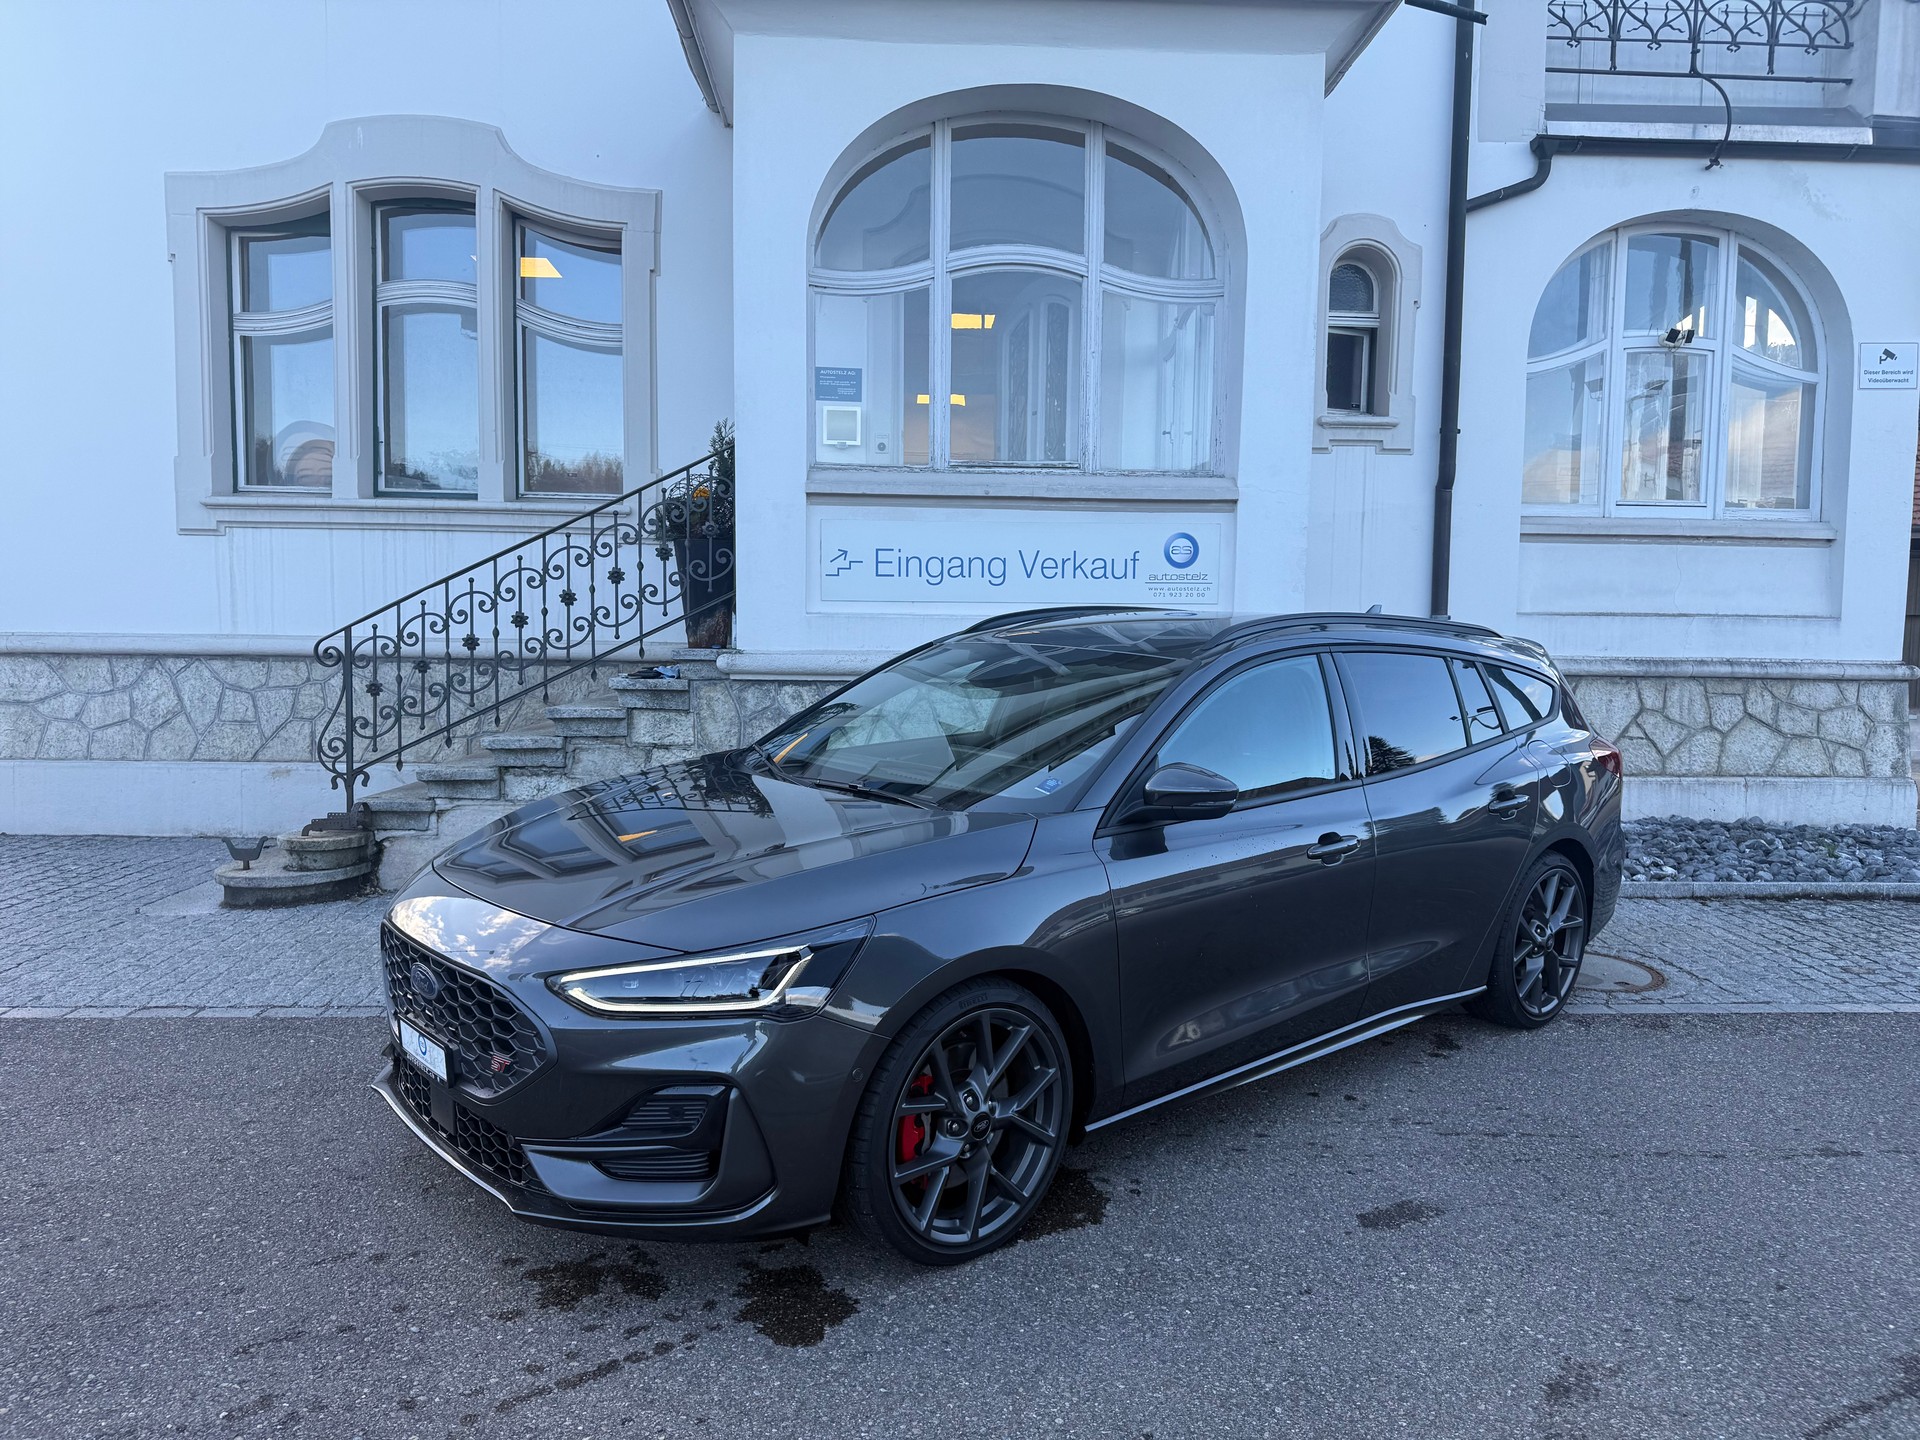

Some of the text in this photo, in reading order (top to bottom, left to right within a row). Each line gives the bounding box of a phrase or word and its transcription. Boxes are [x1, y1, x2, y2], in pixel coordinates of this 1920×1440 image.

[875, 548, 1140, 586] Eingang Verkauf
[1148, 572, 1209, 581] autostelz
[490, 1055, 512, 1073] ST
